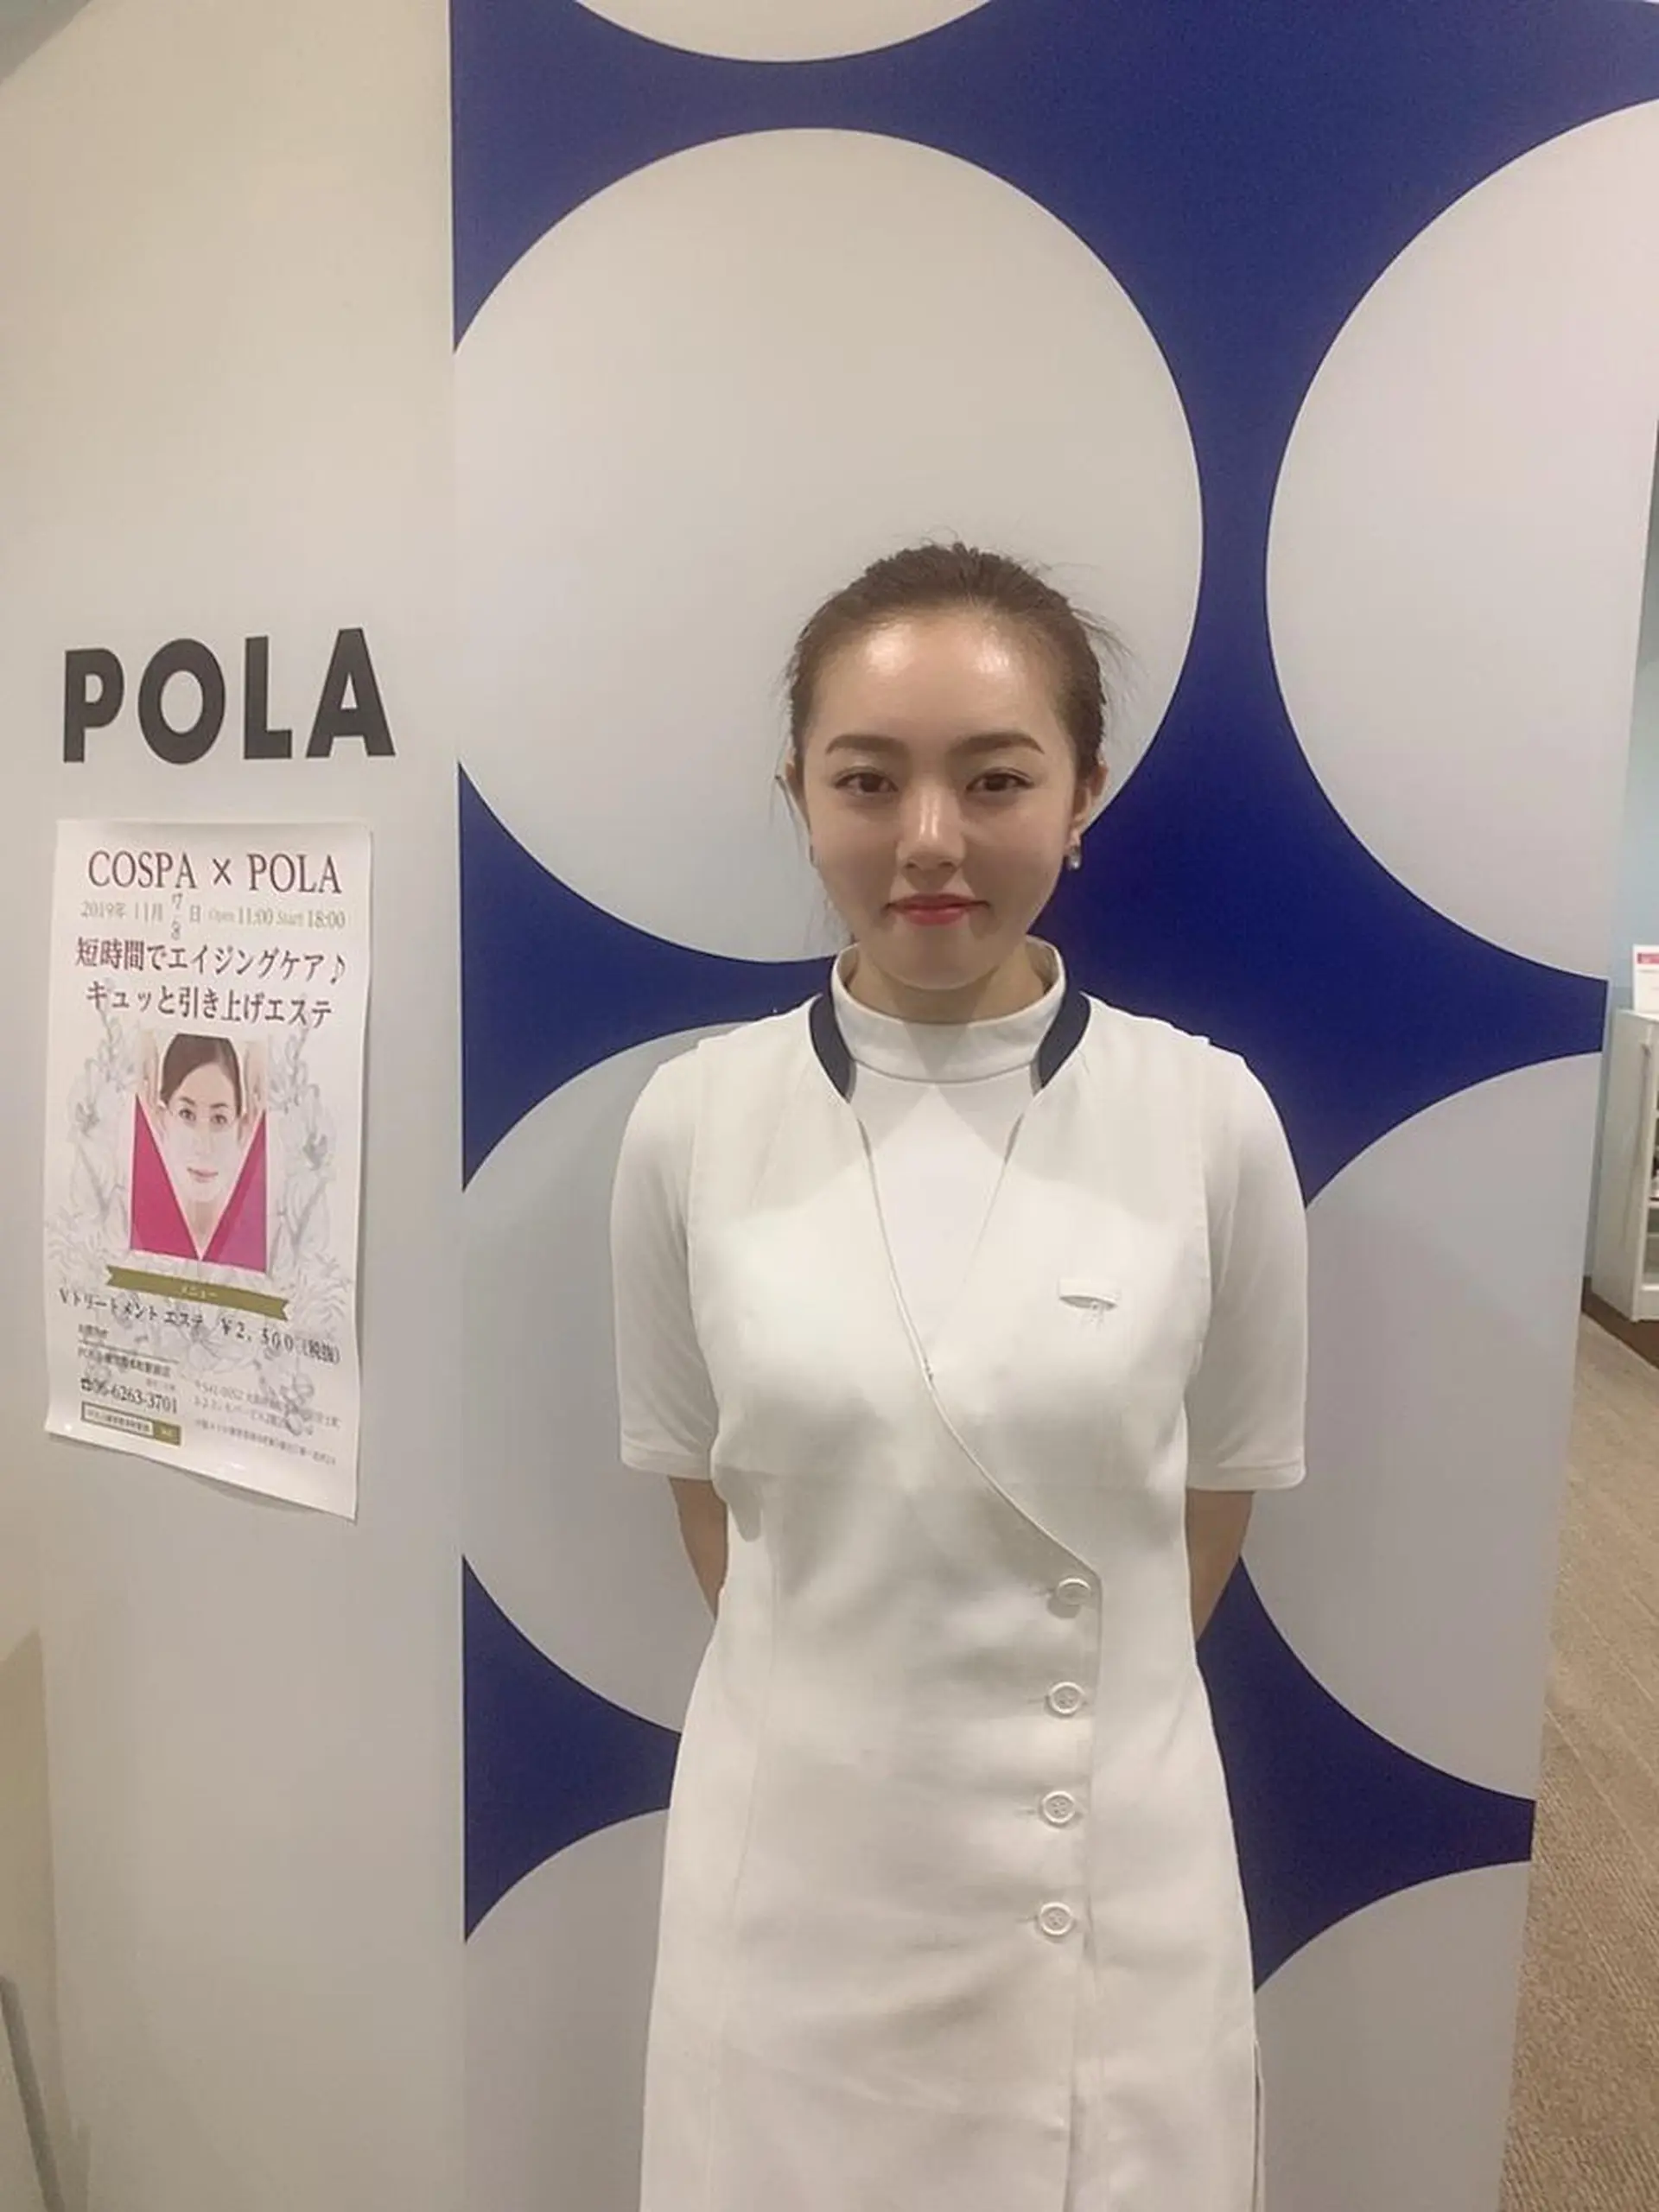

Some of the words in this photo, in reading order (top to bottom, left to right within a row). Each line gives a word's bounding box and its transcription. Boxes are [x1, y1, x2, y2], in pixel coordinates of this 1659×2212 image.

[63, 627, 396, 765] POLA
[87, 849, 198, 890] COSPA
[247, 853, 343, 894] POLA
[80, 900, 126, 918] 2019年
[238, 907, 273, 926] 11:00
[307, 909, 346, 930] 18:00
[86, 980, 333, 1029] キュッと引き上げエステ
